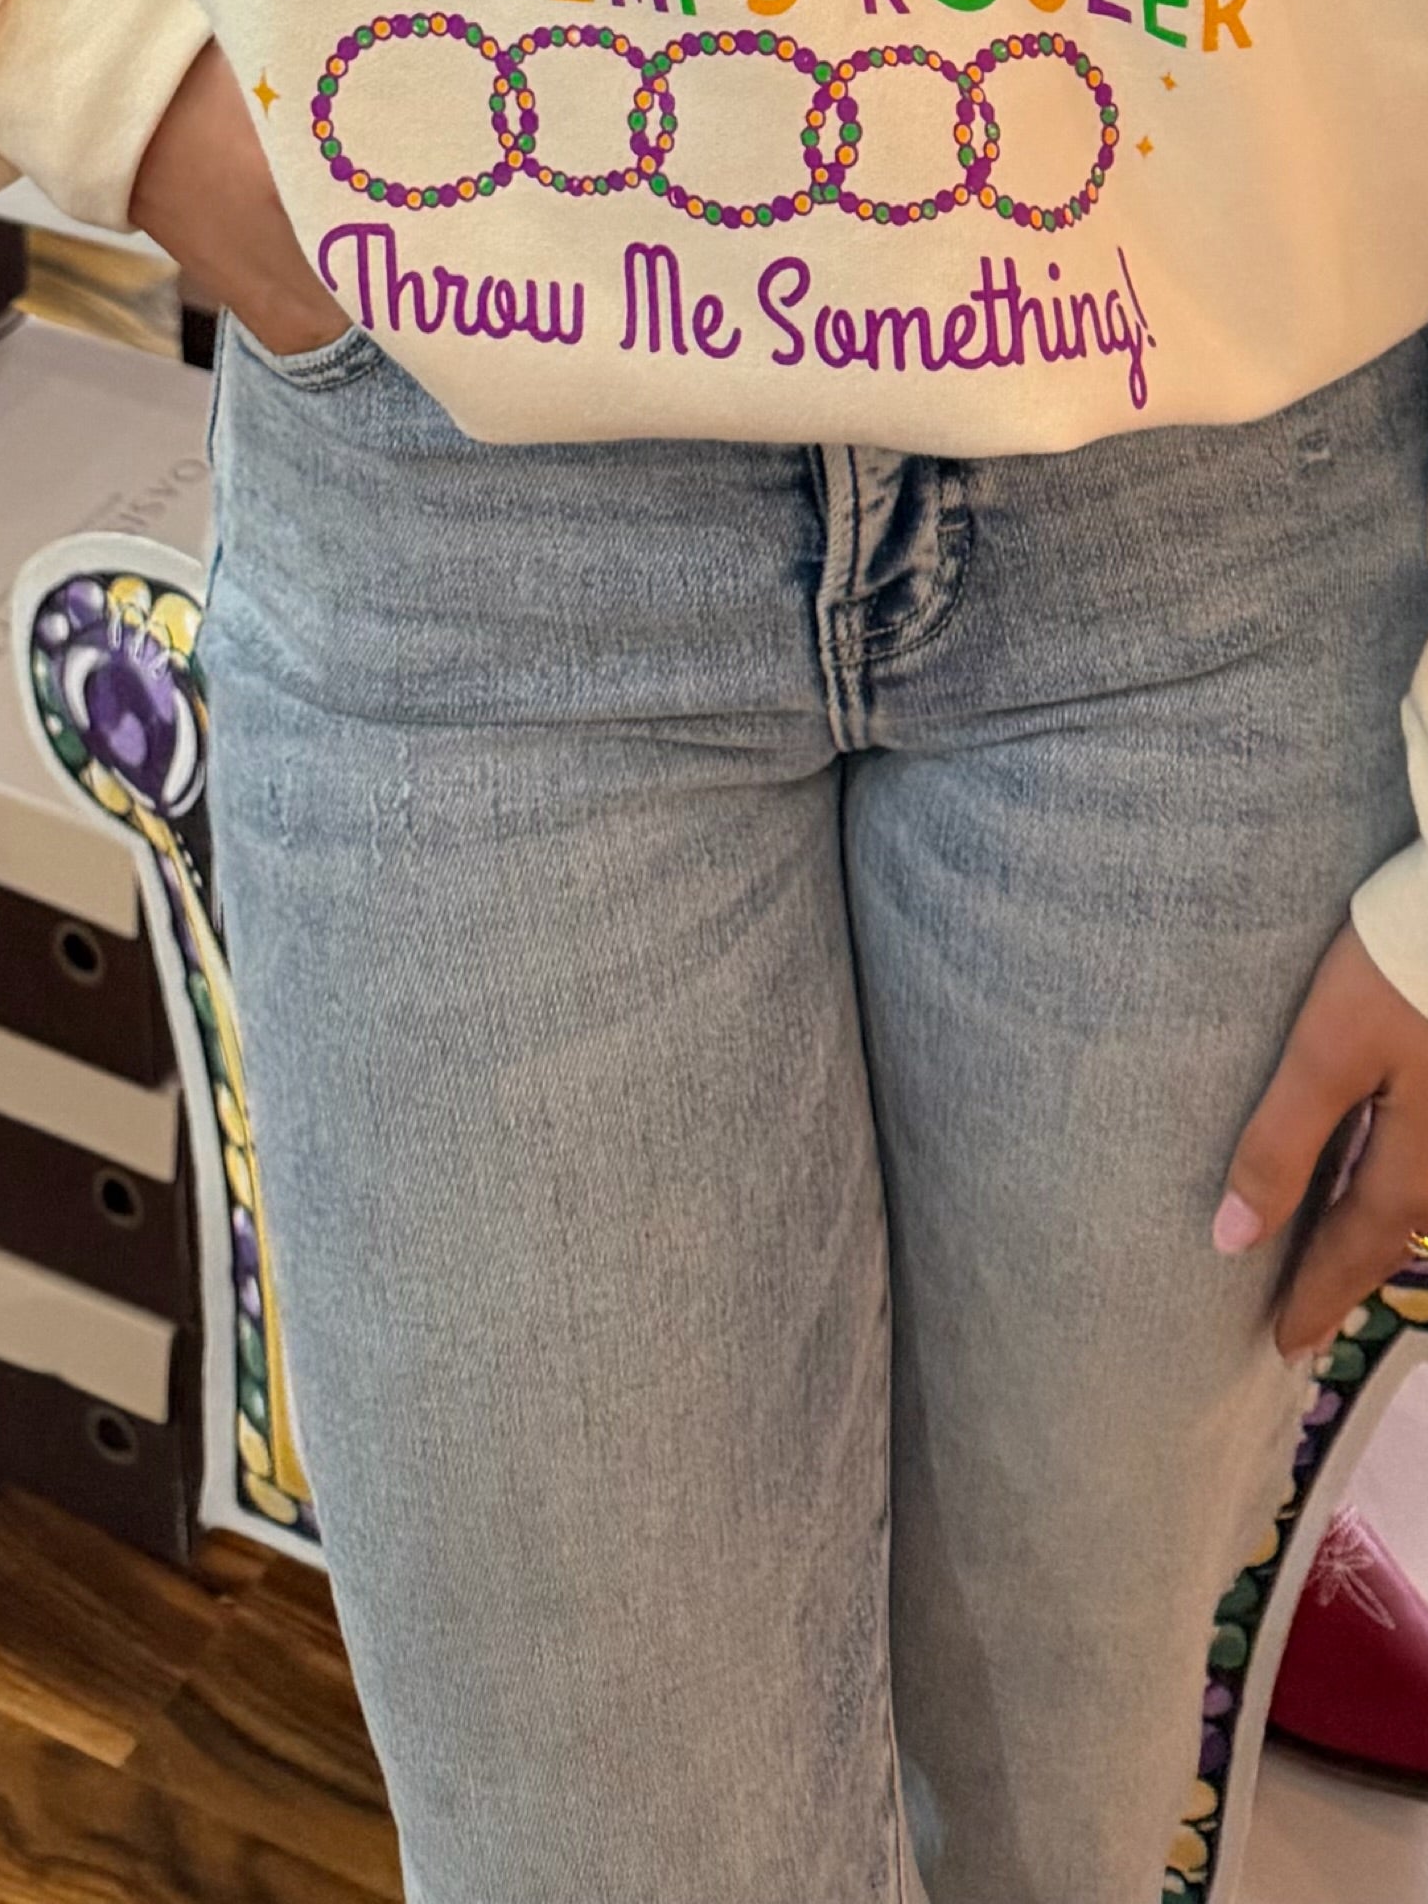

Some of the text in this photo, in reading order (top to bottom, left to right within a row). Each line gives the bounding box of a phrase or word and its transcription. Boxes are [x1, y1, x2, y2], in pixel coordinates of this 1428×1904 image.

[318, 222, 1158, 410] Throw Me Something!
